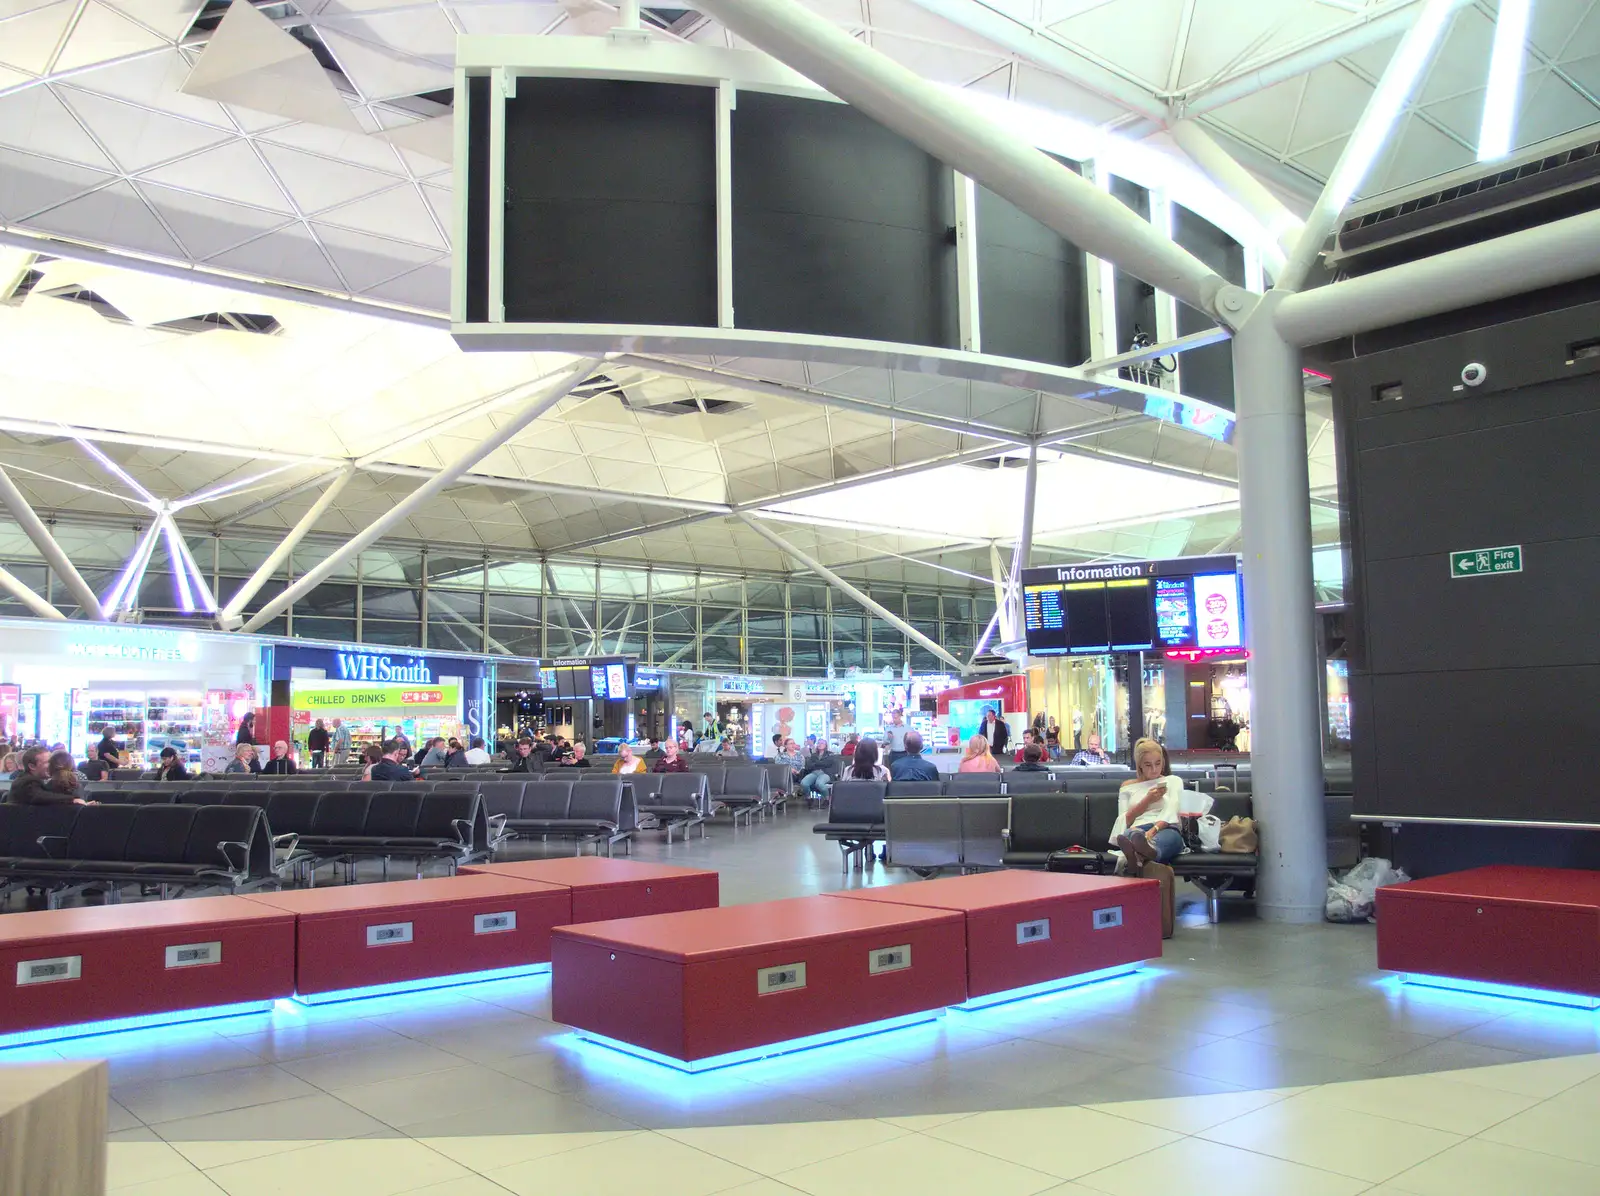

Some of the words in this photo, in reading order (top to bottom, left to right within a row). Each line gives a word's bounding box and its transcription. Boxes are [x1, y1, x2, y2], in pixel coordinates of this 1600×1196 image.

[1493, 551, 1515, 560] Fire
[1495, 560, 1514, 570] exit
[1057, 564, 1141, 580] Information
[553, 658, 587, 666] Information
[337, 653, 431, 683] WHSmith
[306, 695, 345, 705] CHILLED
[351, 693, 385, 704] DRINKS
[467, 698, 480, 708] WH
[468, 707, 480, 736] S
